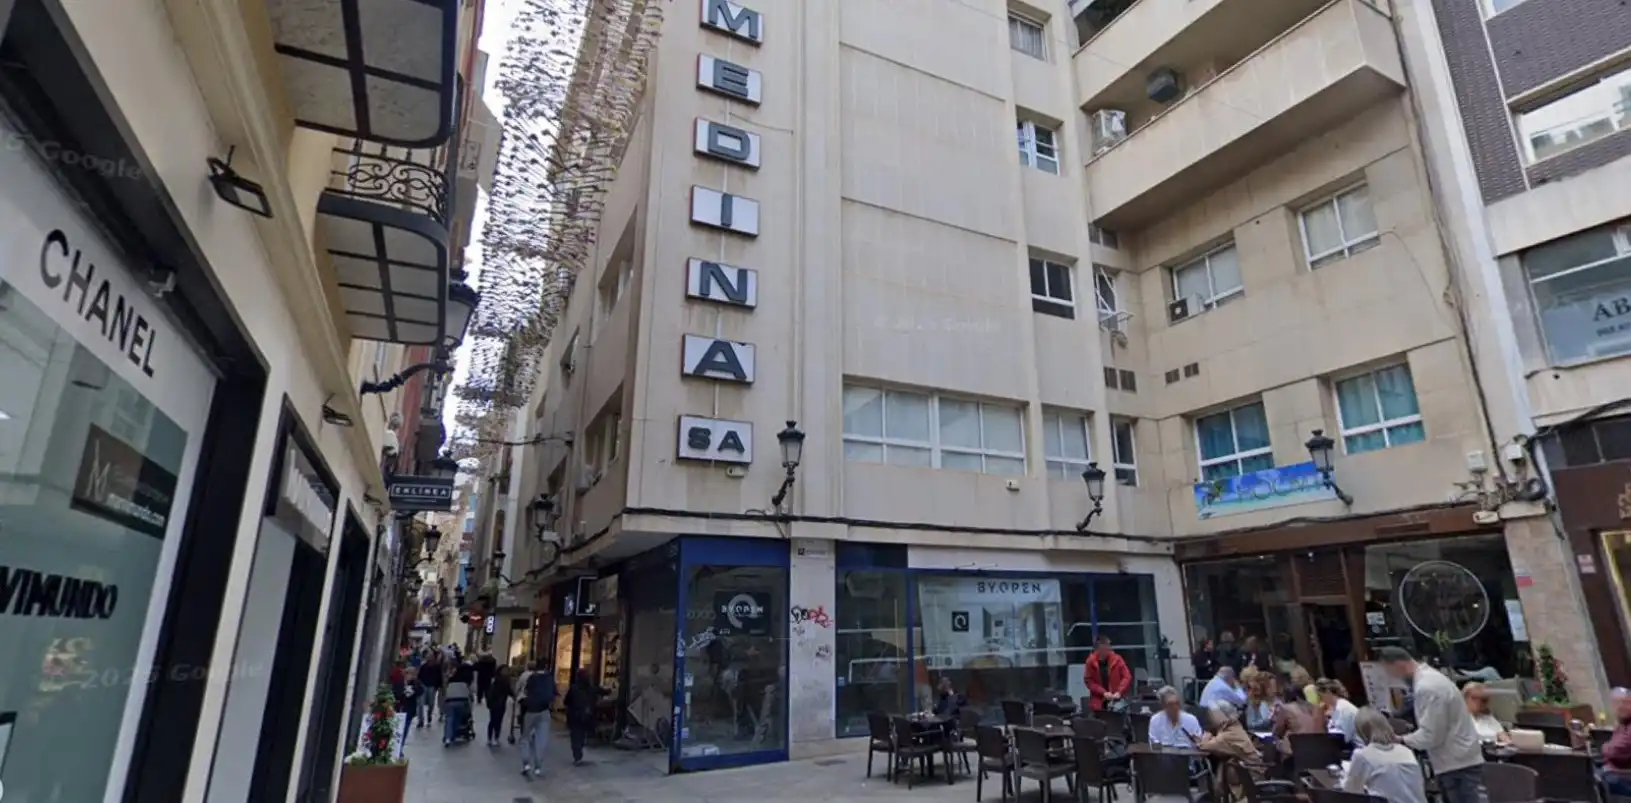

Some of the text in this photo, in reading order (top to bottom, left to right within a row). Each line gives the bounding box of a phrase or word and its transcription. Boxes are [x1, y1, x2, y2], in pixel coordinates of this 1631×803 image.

[692, 0, 758, 380] MEDINA
[40, 229, 156, 378] CHANEL
[687, 426, 746, 454] SA
